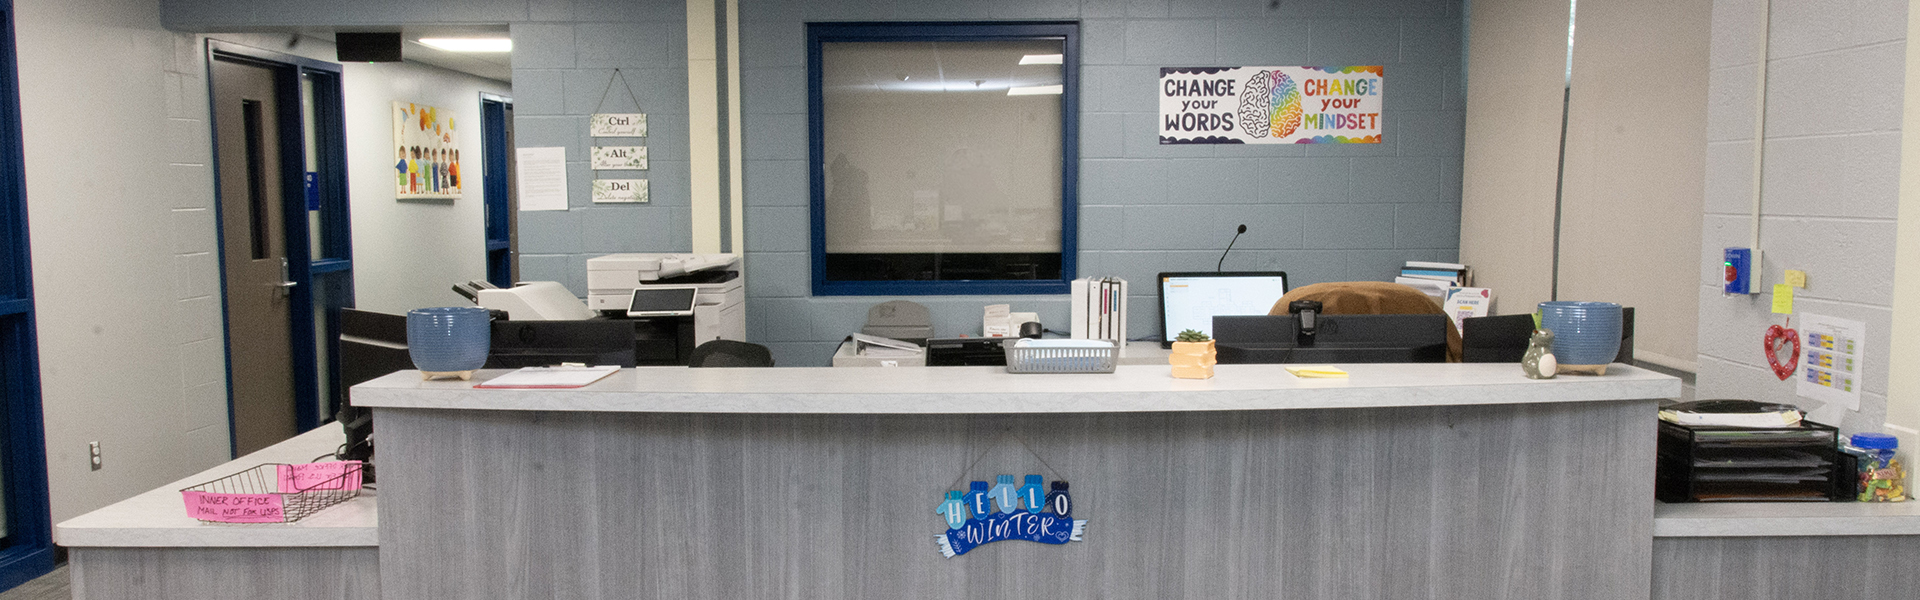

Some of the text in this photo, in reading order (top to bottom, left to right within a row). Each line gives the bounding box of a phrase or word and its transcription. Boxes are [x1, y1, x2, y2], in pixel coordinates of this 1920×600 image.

[1164, 79, 1235, 97] CHANGE
[1304, 79, 1377, 96] CHANGE
[1182, 100, 1218, 112] your
[1321, 98, 1361, 112] your
[608, 117, 629, 125] Ctrl
[1166, 112, 1234, 132] WORDS
[1304, 113, 1378, 130] MINDSET
[610, 149, 627, 158] Alt
[611, 182, 630, 191] Del
[199, 495, 270, 506] INNER OFFICE
[948, 487, 1068, 524] HELLO
[197, 506, 218, 515] MAIL
[222, 508, 240, 516] NOT
[260, 508, 280, 516] USPS
[967, 512, 1055, 545] WINTER
